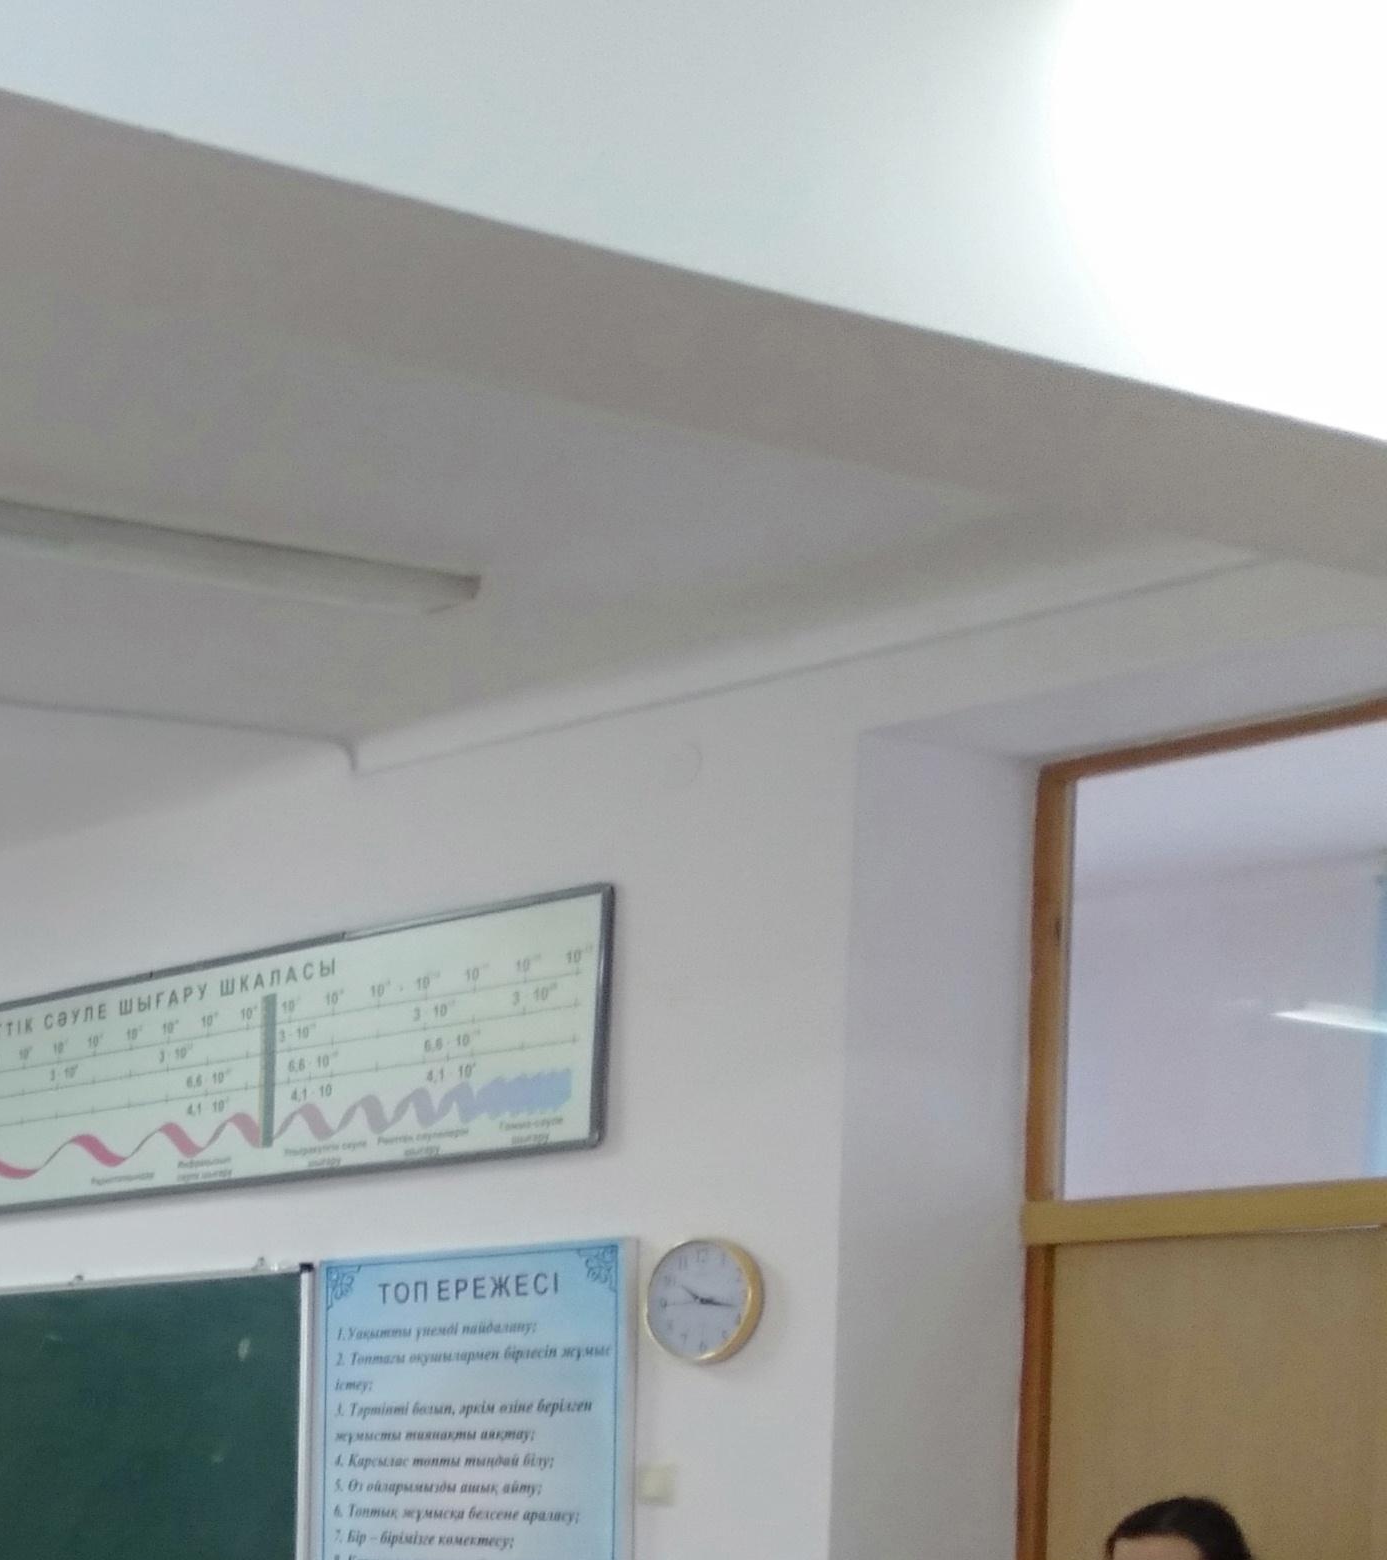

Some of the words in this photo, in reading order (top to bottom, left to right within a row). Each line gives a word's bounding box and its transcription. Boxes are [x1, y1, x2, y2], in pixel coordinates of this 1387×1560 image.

[43, 1001, 107, 1030] СӘУЛЕ
[119, 982, 208, 1015] ШЫҒАРУ
[220, 957, 336, 996] ШКАЛАСЫ
[378, 1280, 428, 1305] ТОП
[436, 1270, 559, 1301] ЕРЕЖЕСІ
